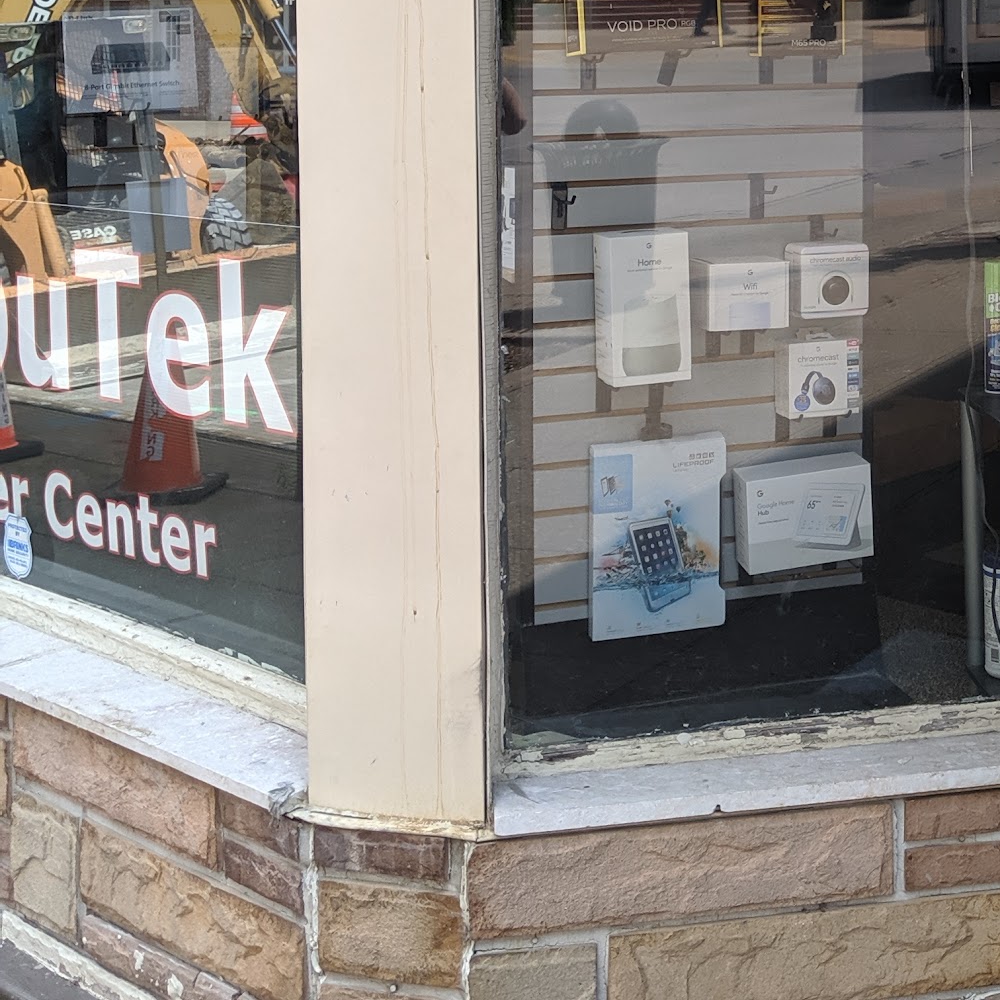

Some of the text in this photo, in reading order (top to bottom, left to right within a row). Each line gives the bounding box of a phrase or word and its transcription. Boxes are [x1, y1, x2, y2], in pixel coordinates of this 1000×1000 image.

[607, 20, 643, 33] VOID
[647, 18, 678, 31] PRO
[637, 258, 662, 267] Home
[743, 282, 758, 291] Wifi
[0, 247, 297, 437] uTek
[797, 354, 840, 363] chromecast
[672, 459, 715, 469] LIFEPROOF
[756, 502, 778, 511] Google
[757, 509, 770, 517] Hub
[44, 468, 217, 580] Center
